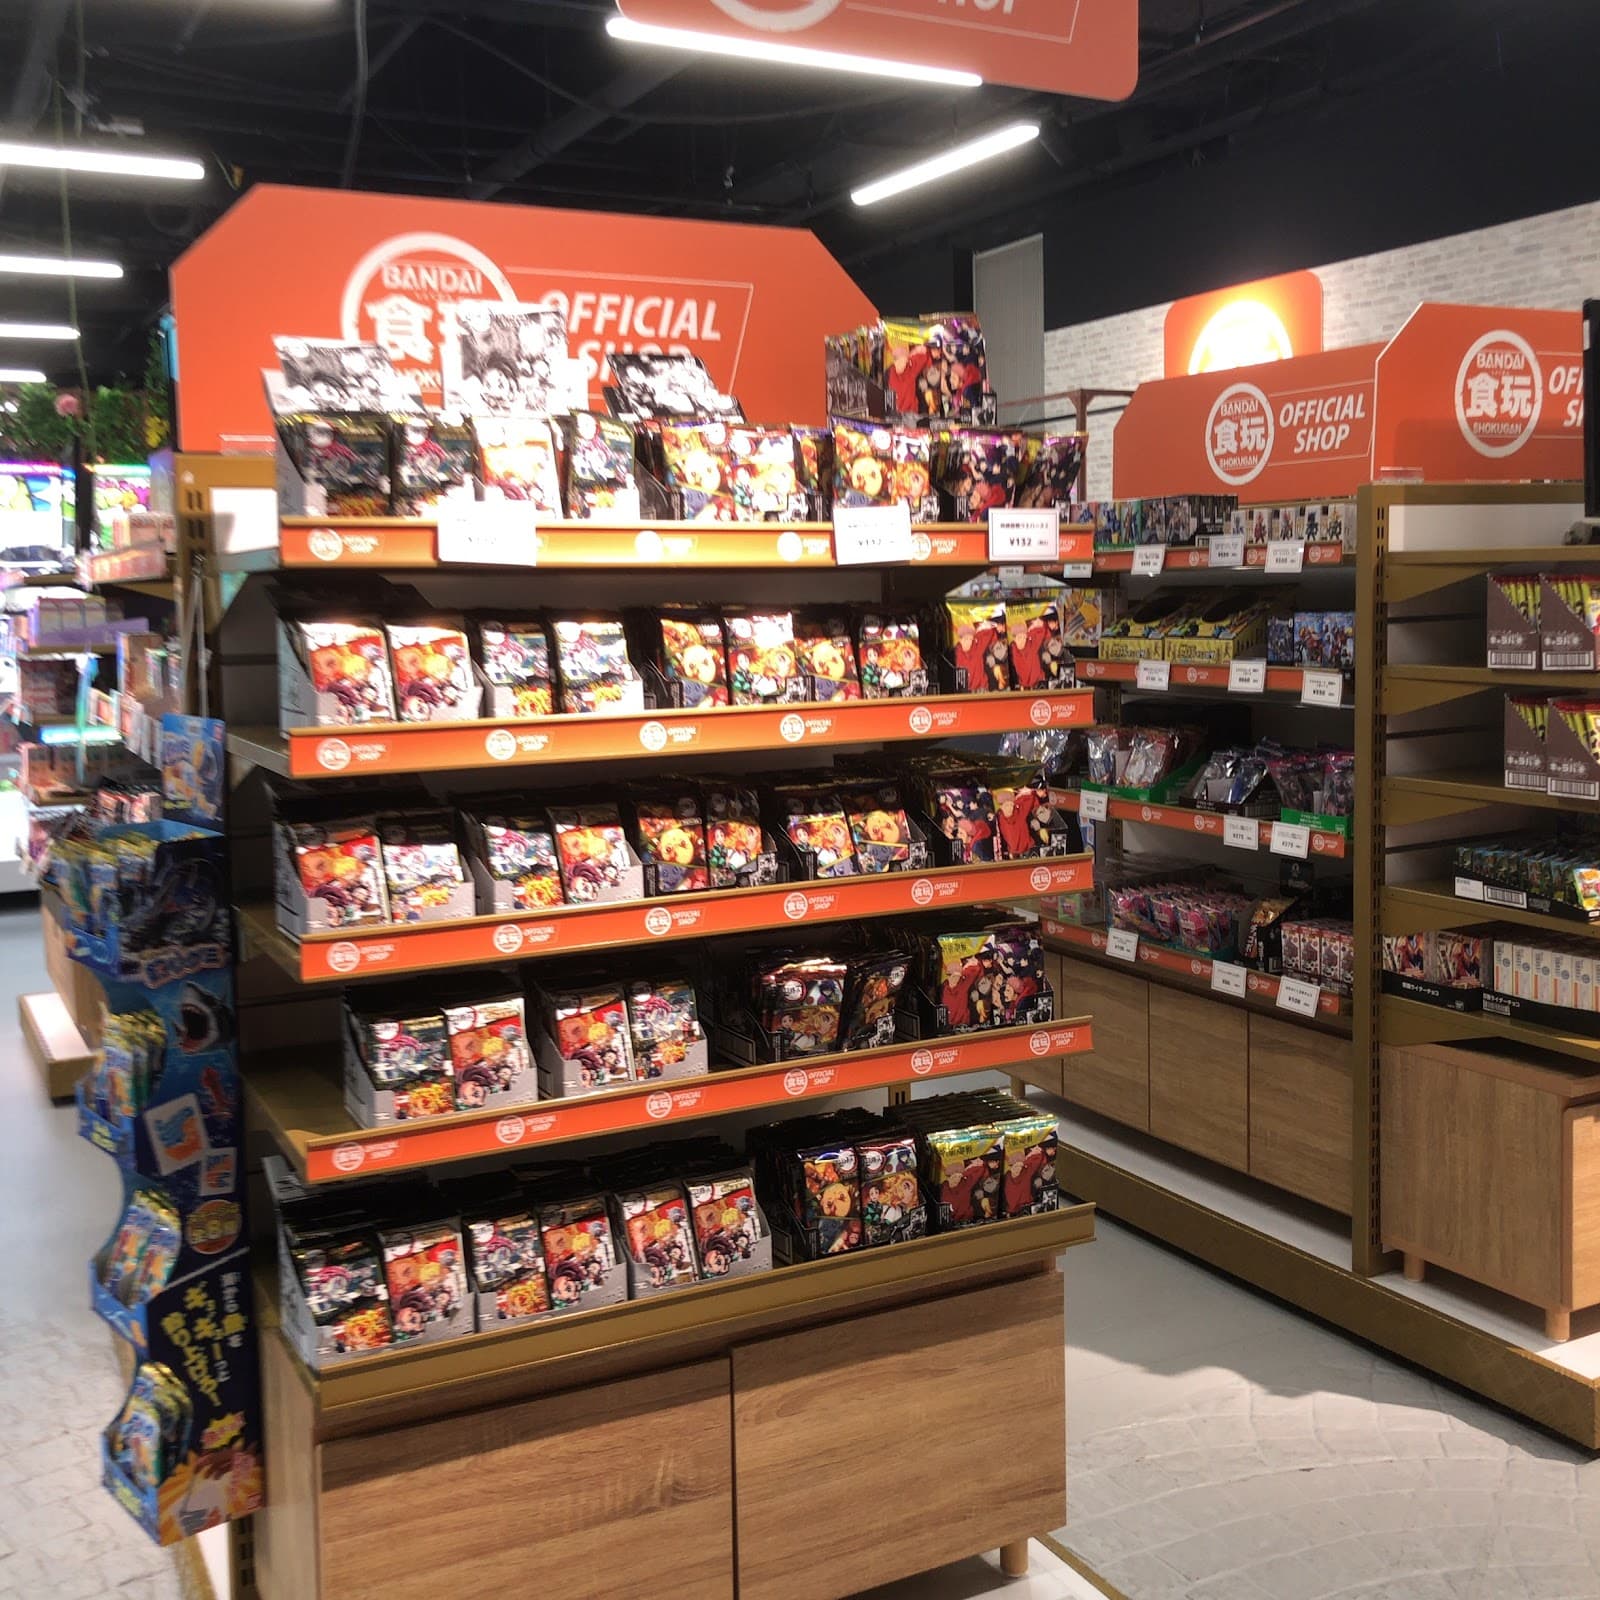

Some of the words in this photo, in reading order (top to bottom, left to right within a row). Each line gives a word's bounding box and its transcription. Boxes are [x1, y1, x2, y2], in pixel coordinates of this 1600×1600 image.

[382, 263, 483, 295] BANDAI
[1476, 352, 1526, 370] BANDAI
[1466, 372, 1533, 419] 食玩
[1220, 399, 1259, 417] BANDAI
[1279, 392, 1366, 429] OFFICIAL
[1473, 422, 1522, 435] SHOKUGAN
[1214, 416, 1265, 456] 食玩
[1293, 423, 1350, 454] SHOP
[1219, 454, 1258, 469] SHOKUGAN
[1009, 536, 1032, 547] ¥132
[1052, 869, 1076, 878] OFFICIAL
[1056, 876, 1072, 884] SHOP
[939, 888, 955, 897] SHOP
[1050, 1031, 1075, 1042] OFFICIAL
[1055, 1039, 1071, 1048] SHOP
[933, 1049, 959, 1060] OFFICIAL
[938, 1057, 955, 1066] SHOP
